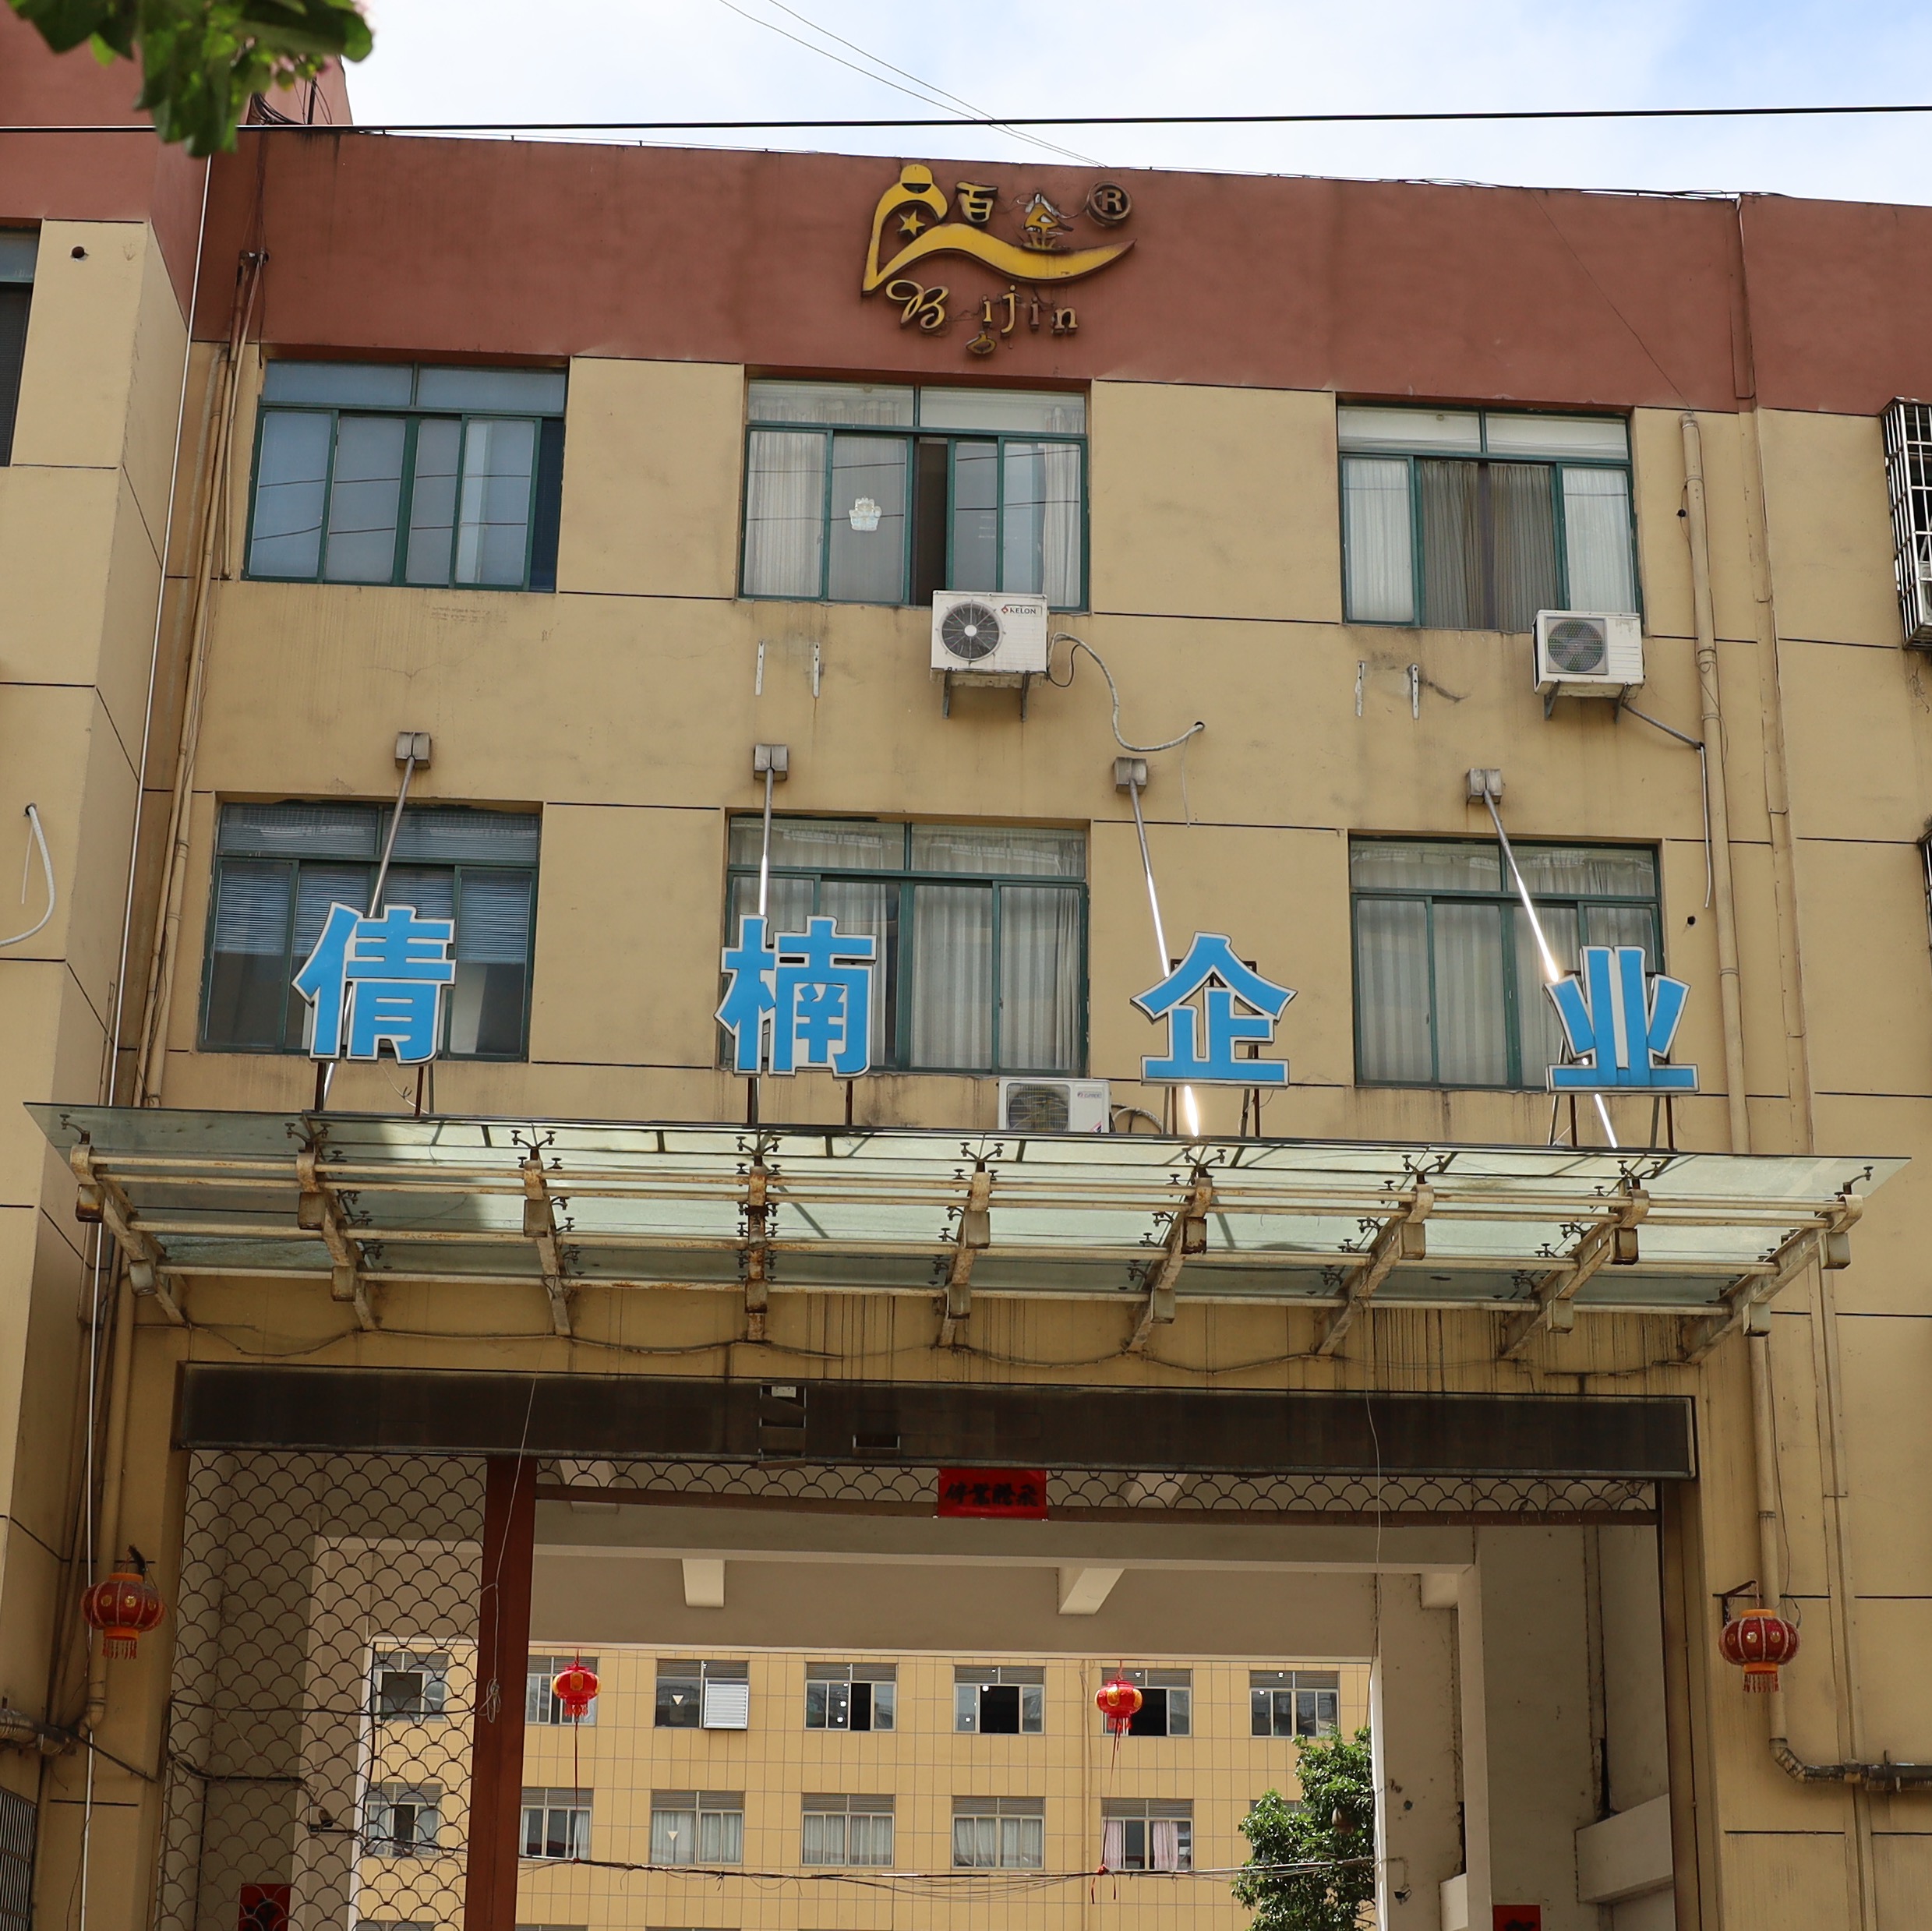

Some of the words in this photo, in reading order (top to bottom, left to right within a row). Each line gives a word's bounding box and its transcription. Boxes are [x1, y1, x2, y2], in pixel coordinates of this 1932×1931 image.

[1009, 606, 1037, 615] KELON
[291, 901, 1700, 1094] 倩楠企业
